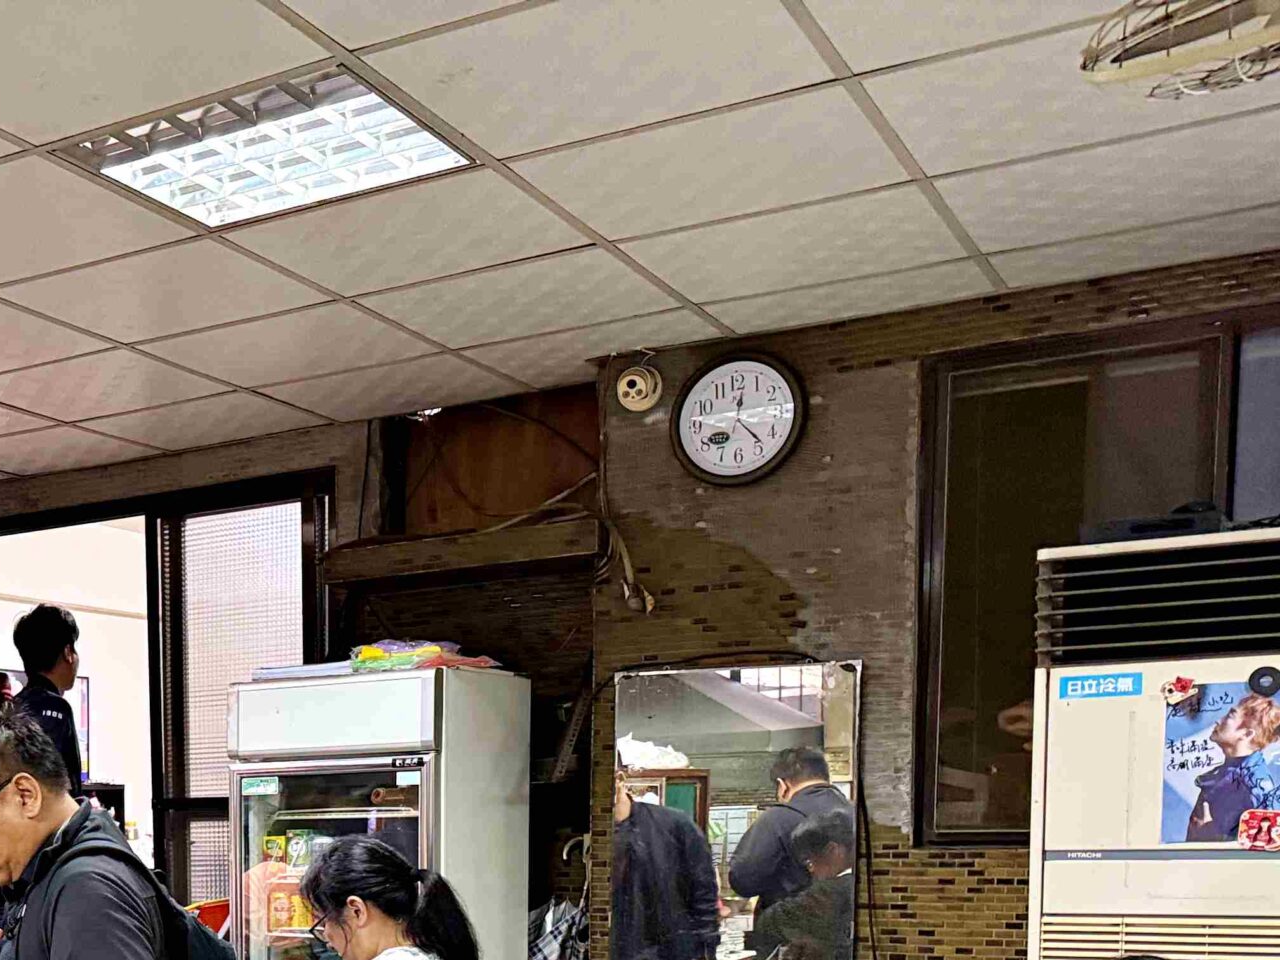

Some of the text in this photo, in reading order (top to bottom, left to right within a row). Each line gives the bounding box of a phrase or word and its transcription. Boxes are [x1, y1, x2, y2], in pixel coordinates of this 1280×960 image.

[730, 374, 745, 391] 12
[755, 375, 759, 392] 1
[714, 383, 725, 399] 11
[767, 386, 776, 402] 2
[698, 399, 713, 416] 10
[774, 404, 783, 419] 3
[693, 421, 702, 434] 9
[767, 424, 777, 439] 4
[701, 436, 710, 452] 8
[753, 441, 763, 456] 5
[717, 447, 725, 462] 7
[734, 449, 743, 463] 6
[1067, 677, 1134, 695] 日立冷氣
